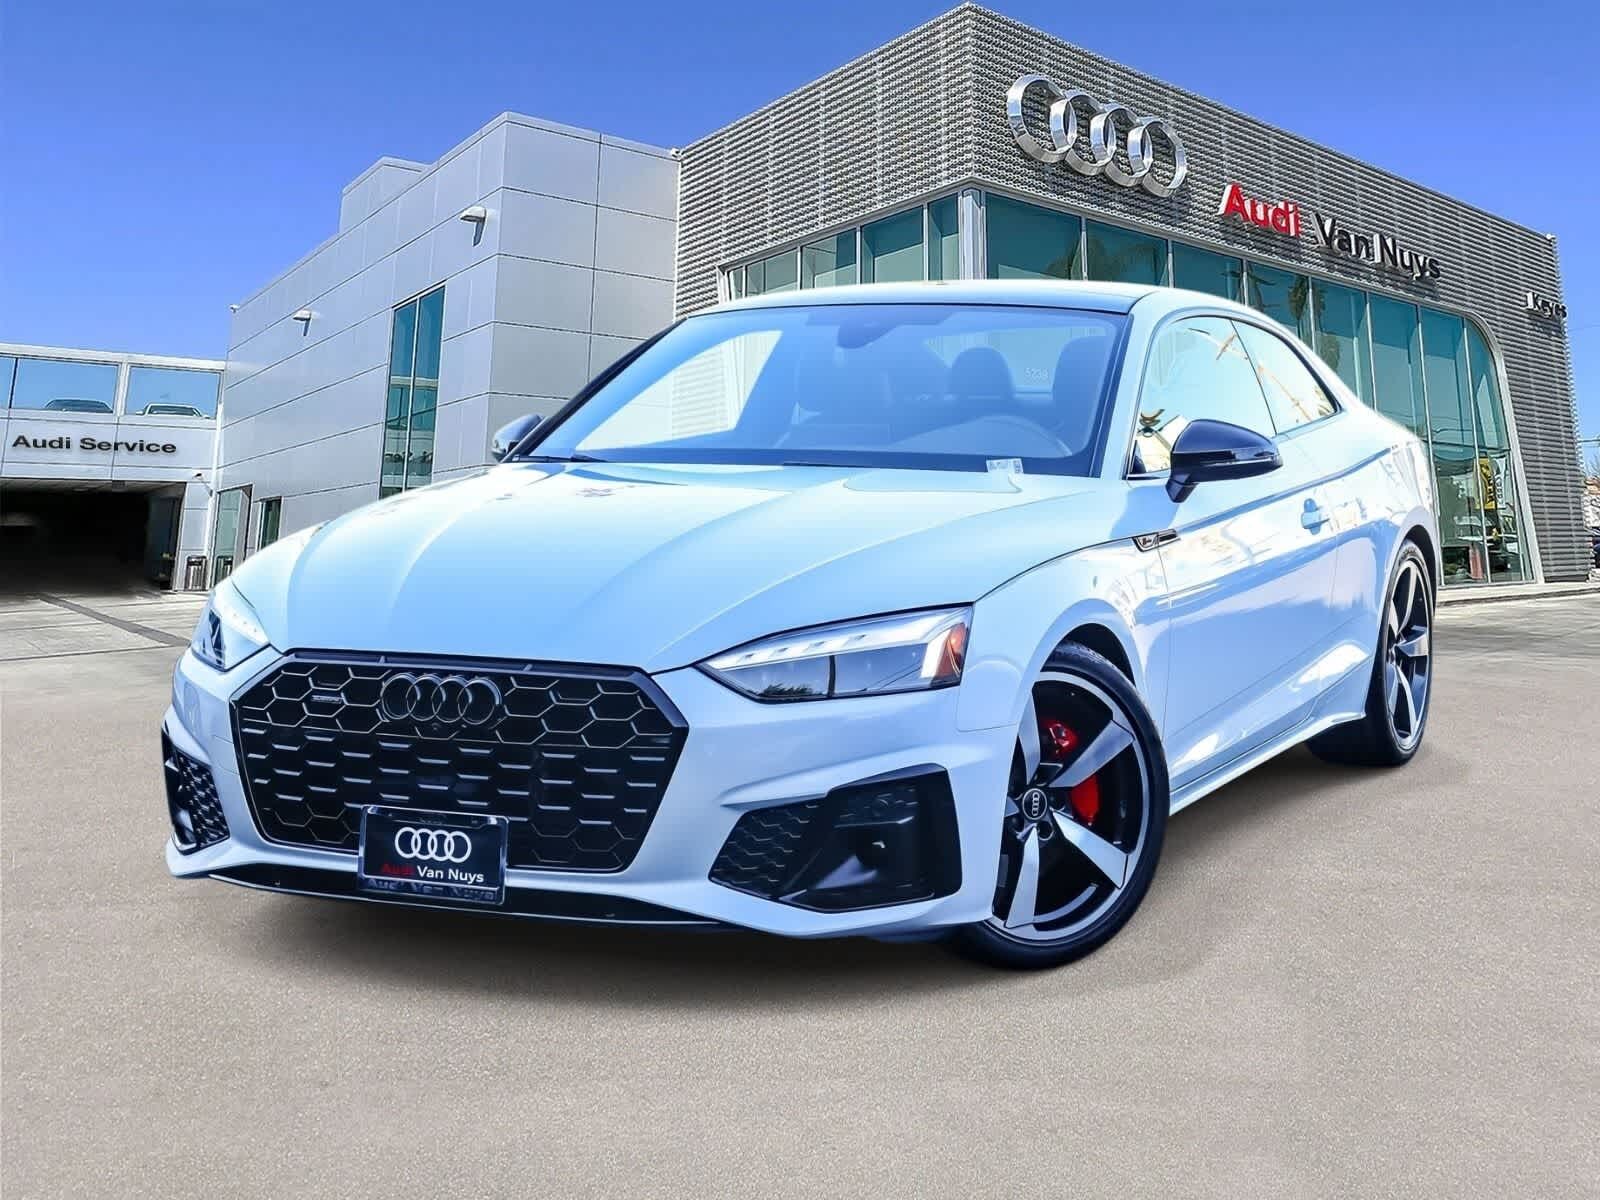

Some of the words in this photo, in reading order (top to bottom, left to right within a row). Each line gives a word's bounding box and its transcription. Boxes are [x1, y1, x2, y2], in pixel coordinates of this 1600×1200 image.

[1218, 182, 1301, 237] Audi
[1312, 211, 1371, 258] Van
[1374, 233, 1441, 280] Nuys
[1526, 291, 1568, 320] Keyes
[12, 435, 71, 449] Audi
[80, 437, 177, 454] Service
[381, 863, 414, 876] Audi
[417, 865, 444, 880] Van
[448, 868, 485, 885] Nuys
